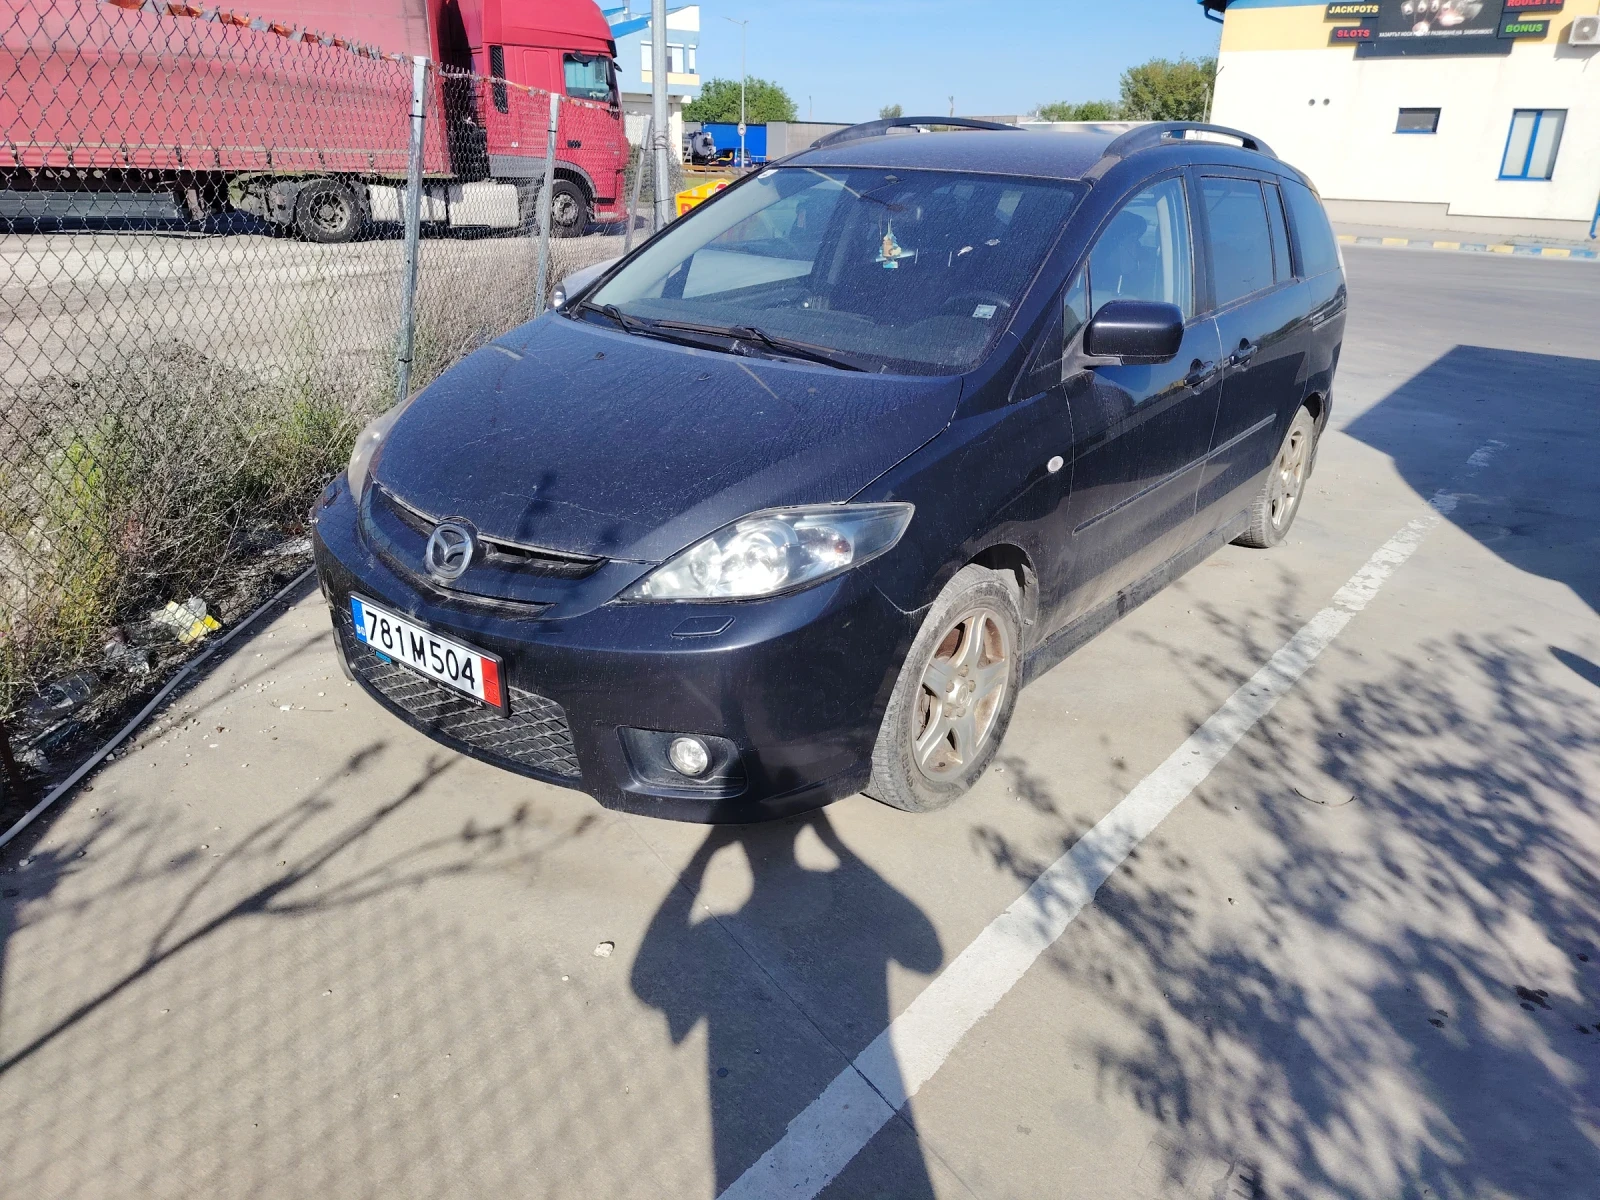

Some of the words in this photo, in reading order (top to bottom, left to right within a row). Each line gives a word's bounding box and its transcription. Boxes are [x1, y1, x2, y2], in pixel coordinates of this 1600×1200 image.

[1328, 4, 1379, 14] JACKPOTS
[1505, 23, 1543, 33] BONUS
[1337, 29, 1371, 38] SLOTS
